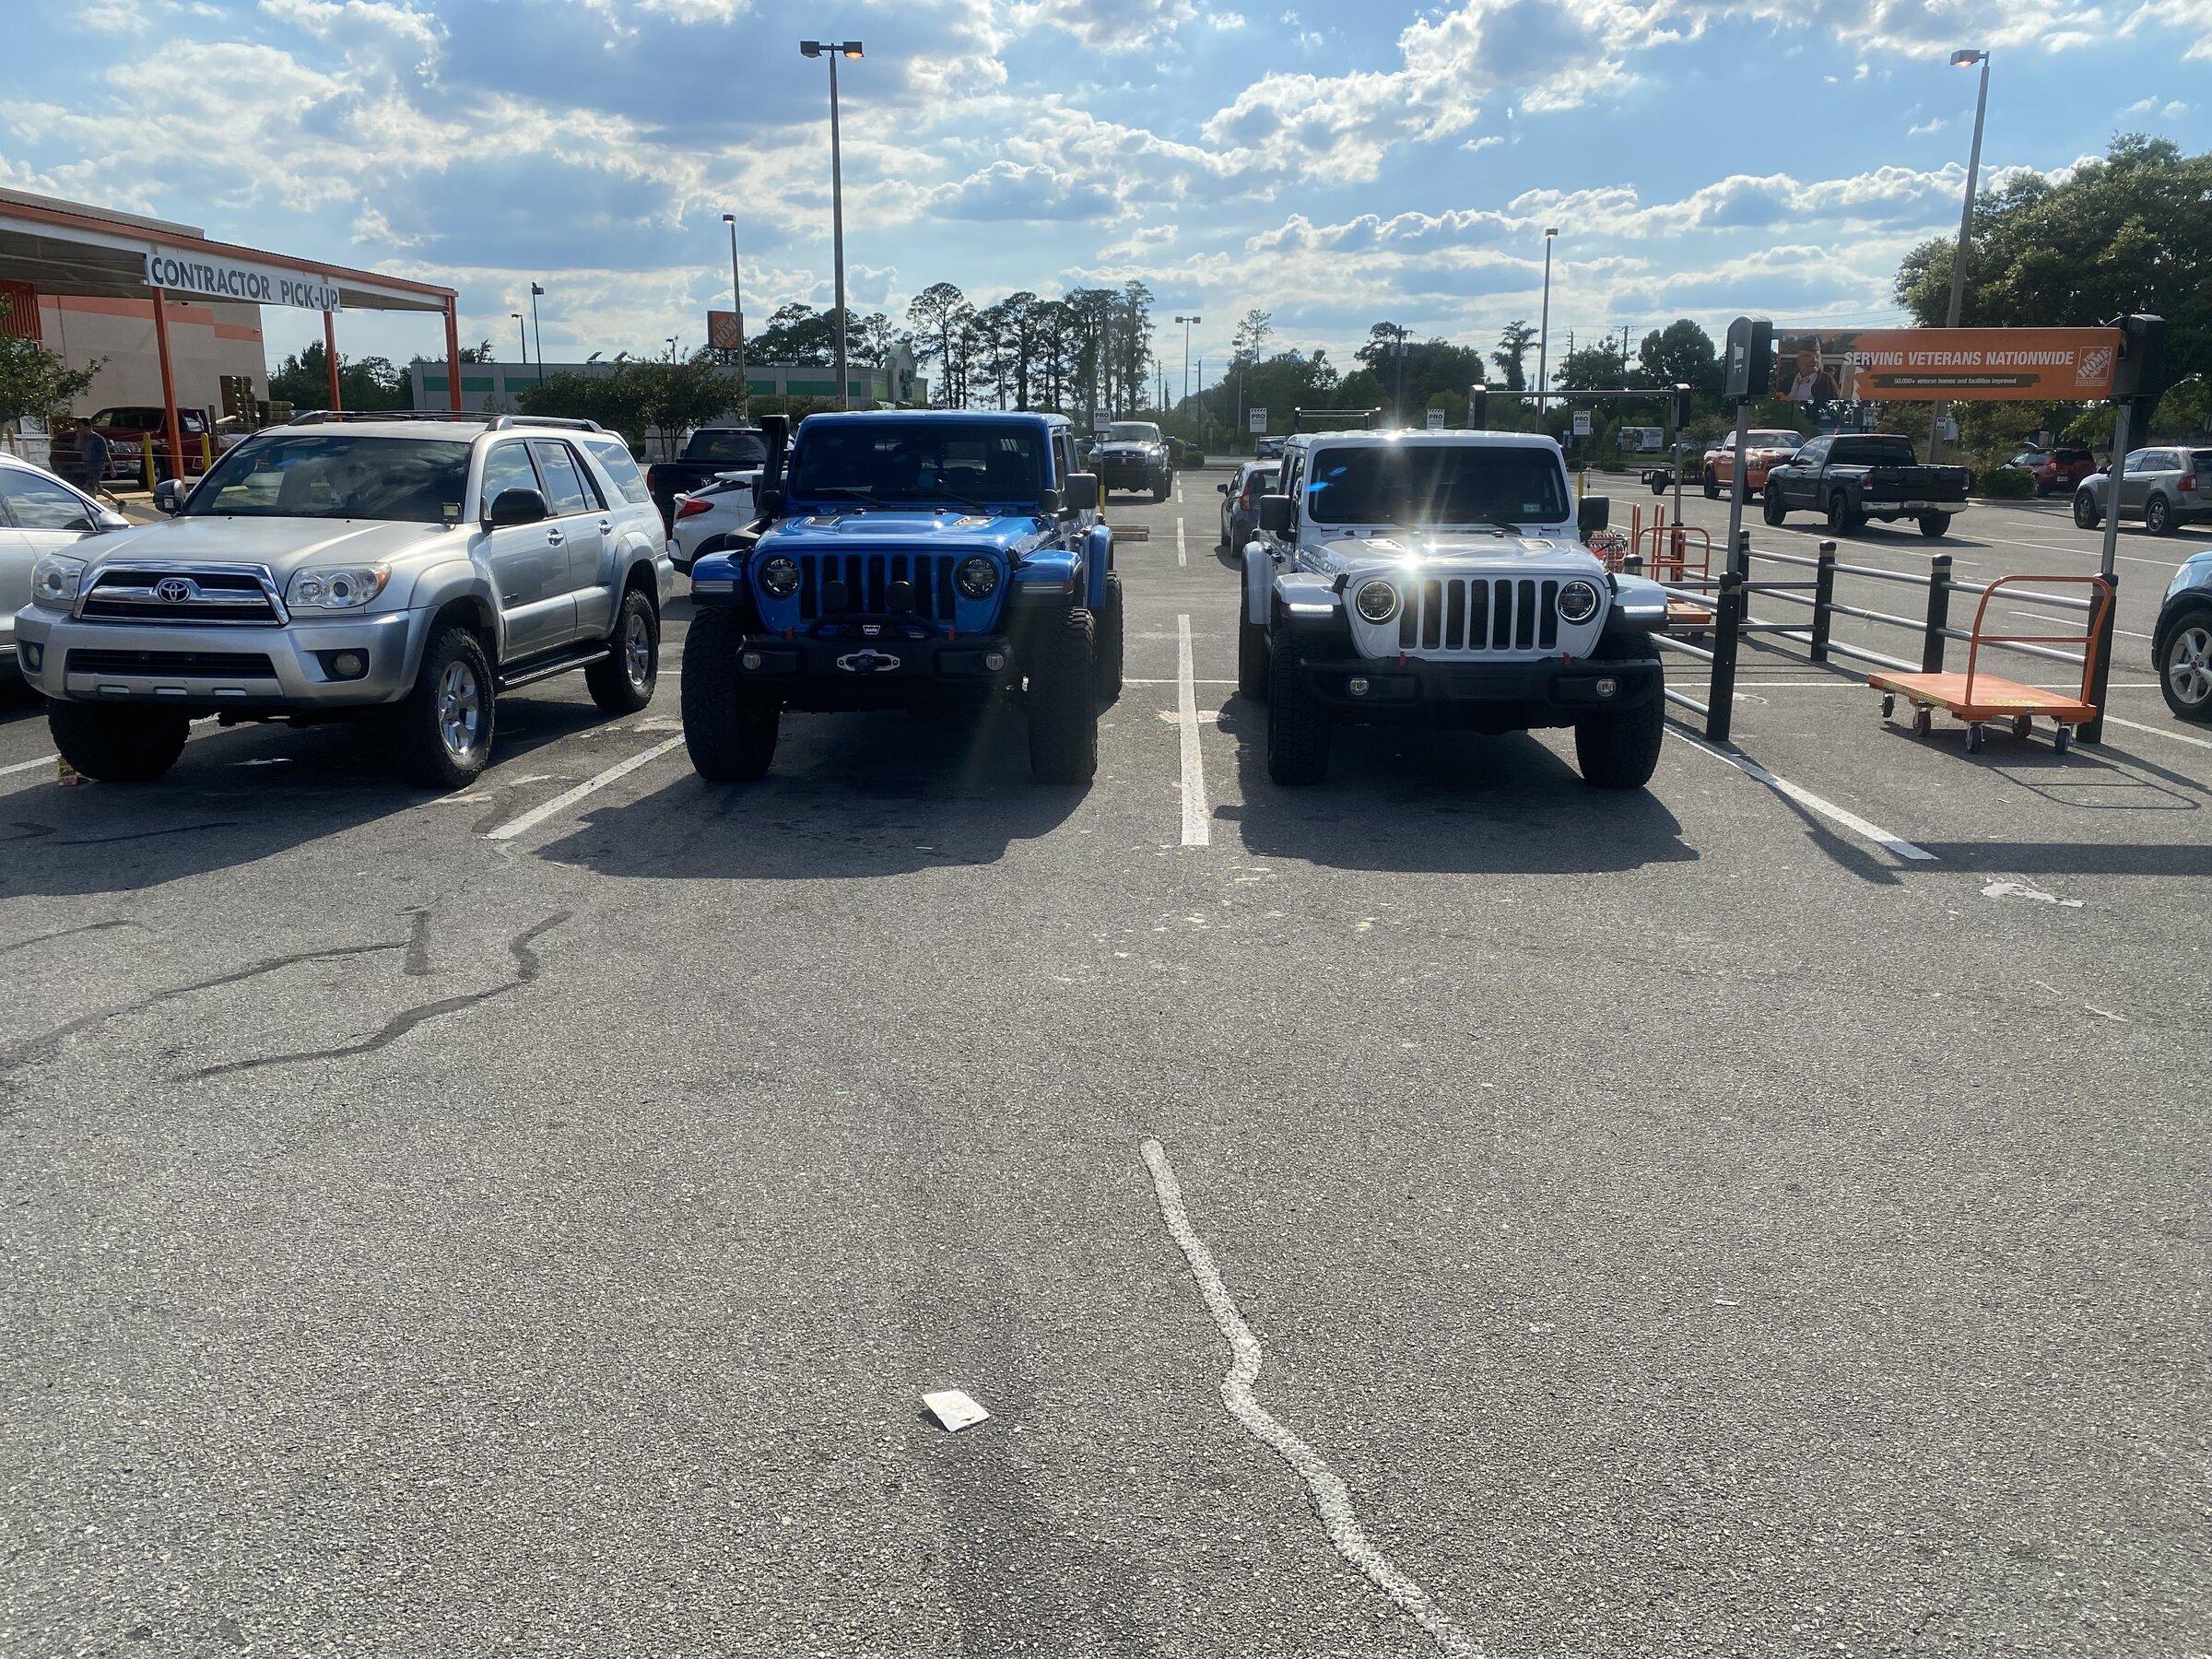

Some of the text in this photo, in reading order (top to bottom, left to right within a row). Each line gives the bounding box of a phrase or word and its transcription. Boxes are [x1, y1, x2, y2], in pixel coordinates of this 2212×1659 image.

[151, 257, 338, 312] CONTRACTOR PICK-UP
[1843, 350, 2075, 366] SERVING VETERANS NATIONWIDE
